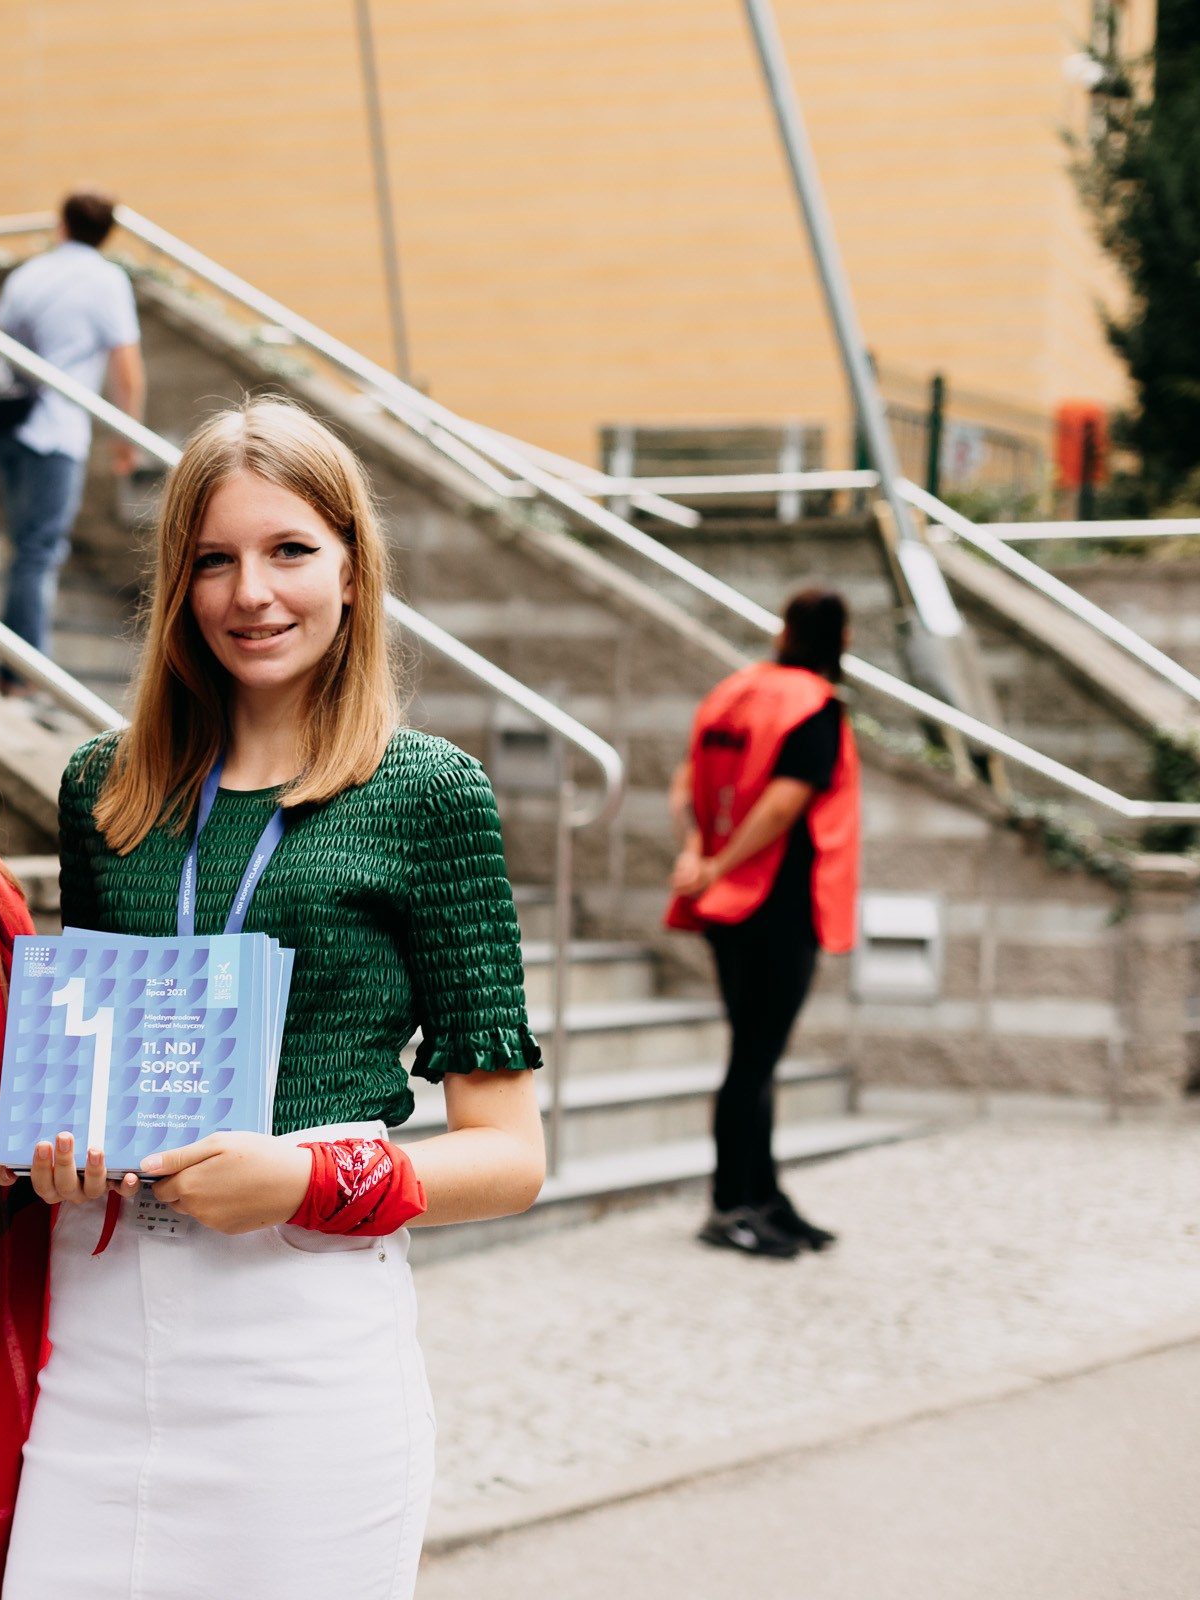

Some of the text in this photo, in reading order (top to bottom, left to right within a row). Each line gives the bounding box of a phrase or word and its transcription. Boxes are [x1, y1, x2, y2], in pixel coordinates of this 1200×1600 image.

[184, 867, 193, 889] SOPOT
[235, 853, 265, 915] NDI SOPOT CLASSIC
[182, 888, 190, 916] CLASSIC
[145, 988, 187, 997] lipca 2021
[172, 1022, 205, 1030] Muzyczny
[142, 1041, 197, 1055] 11. NDI
[141, 1060, 201, 1074] SOPOT
[139, 1079, 210, 1094] CLASSIC
[137, 1112, 206, 1121] Dyrektor Artystyczny
[136, 1120, 166, 1129] Wojciech
